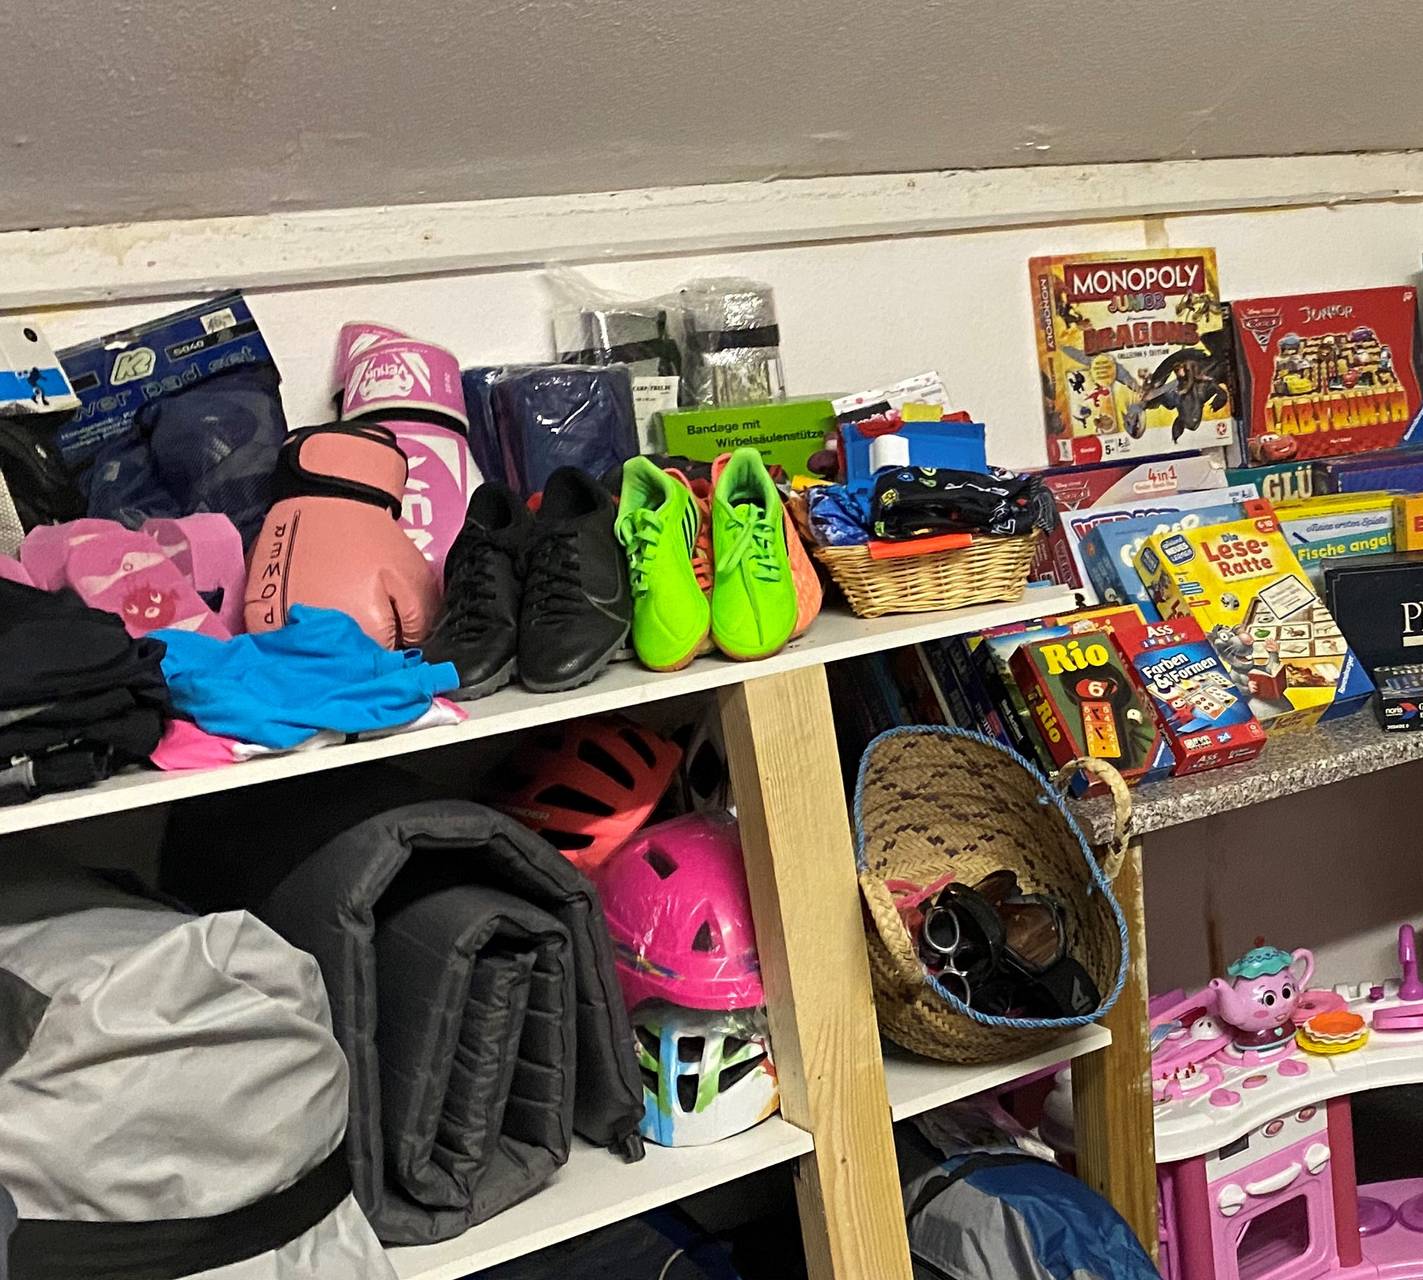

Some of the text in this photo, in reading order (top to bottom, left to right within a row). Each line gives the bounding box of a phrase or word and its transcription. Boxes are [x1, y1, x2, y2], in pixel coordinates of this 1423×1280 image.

[1073, 263, 1199, 296] MONOPOLY
[1039, 278, 1056, 349] MONOPOLY
[1108, 292, 1167, 313] JUNIOR
[1298, 304, 1354, 324] JUNIOR
[1084, 321, 1201, 356] DRAGONS
[114, 348, 154, 381] K2
[141, 362, 202, 400] pad
[207, 345, 256, 373] set
[1265, 386, 1409, 436] LABYRINTH
[687, 419, 761, 436] Bandage mit
[716, 428, 825, 448] Wirbelsäulenstütze
[1200, 538, 1269, 563] Lese-
[1297, 544, 1346, 562] Fische
[1217, 557, 1274, 578] Ratte
[1039, 640, 1109, 675] Rio
[1141, 653, 1189, 680] Farben
[1171, 656, 1218, 684] Formen
[1088, 681, 1104, 697] 6
[1035, 699, 1061, 744] Rio
[1385, 706, 1404, 715] noris
